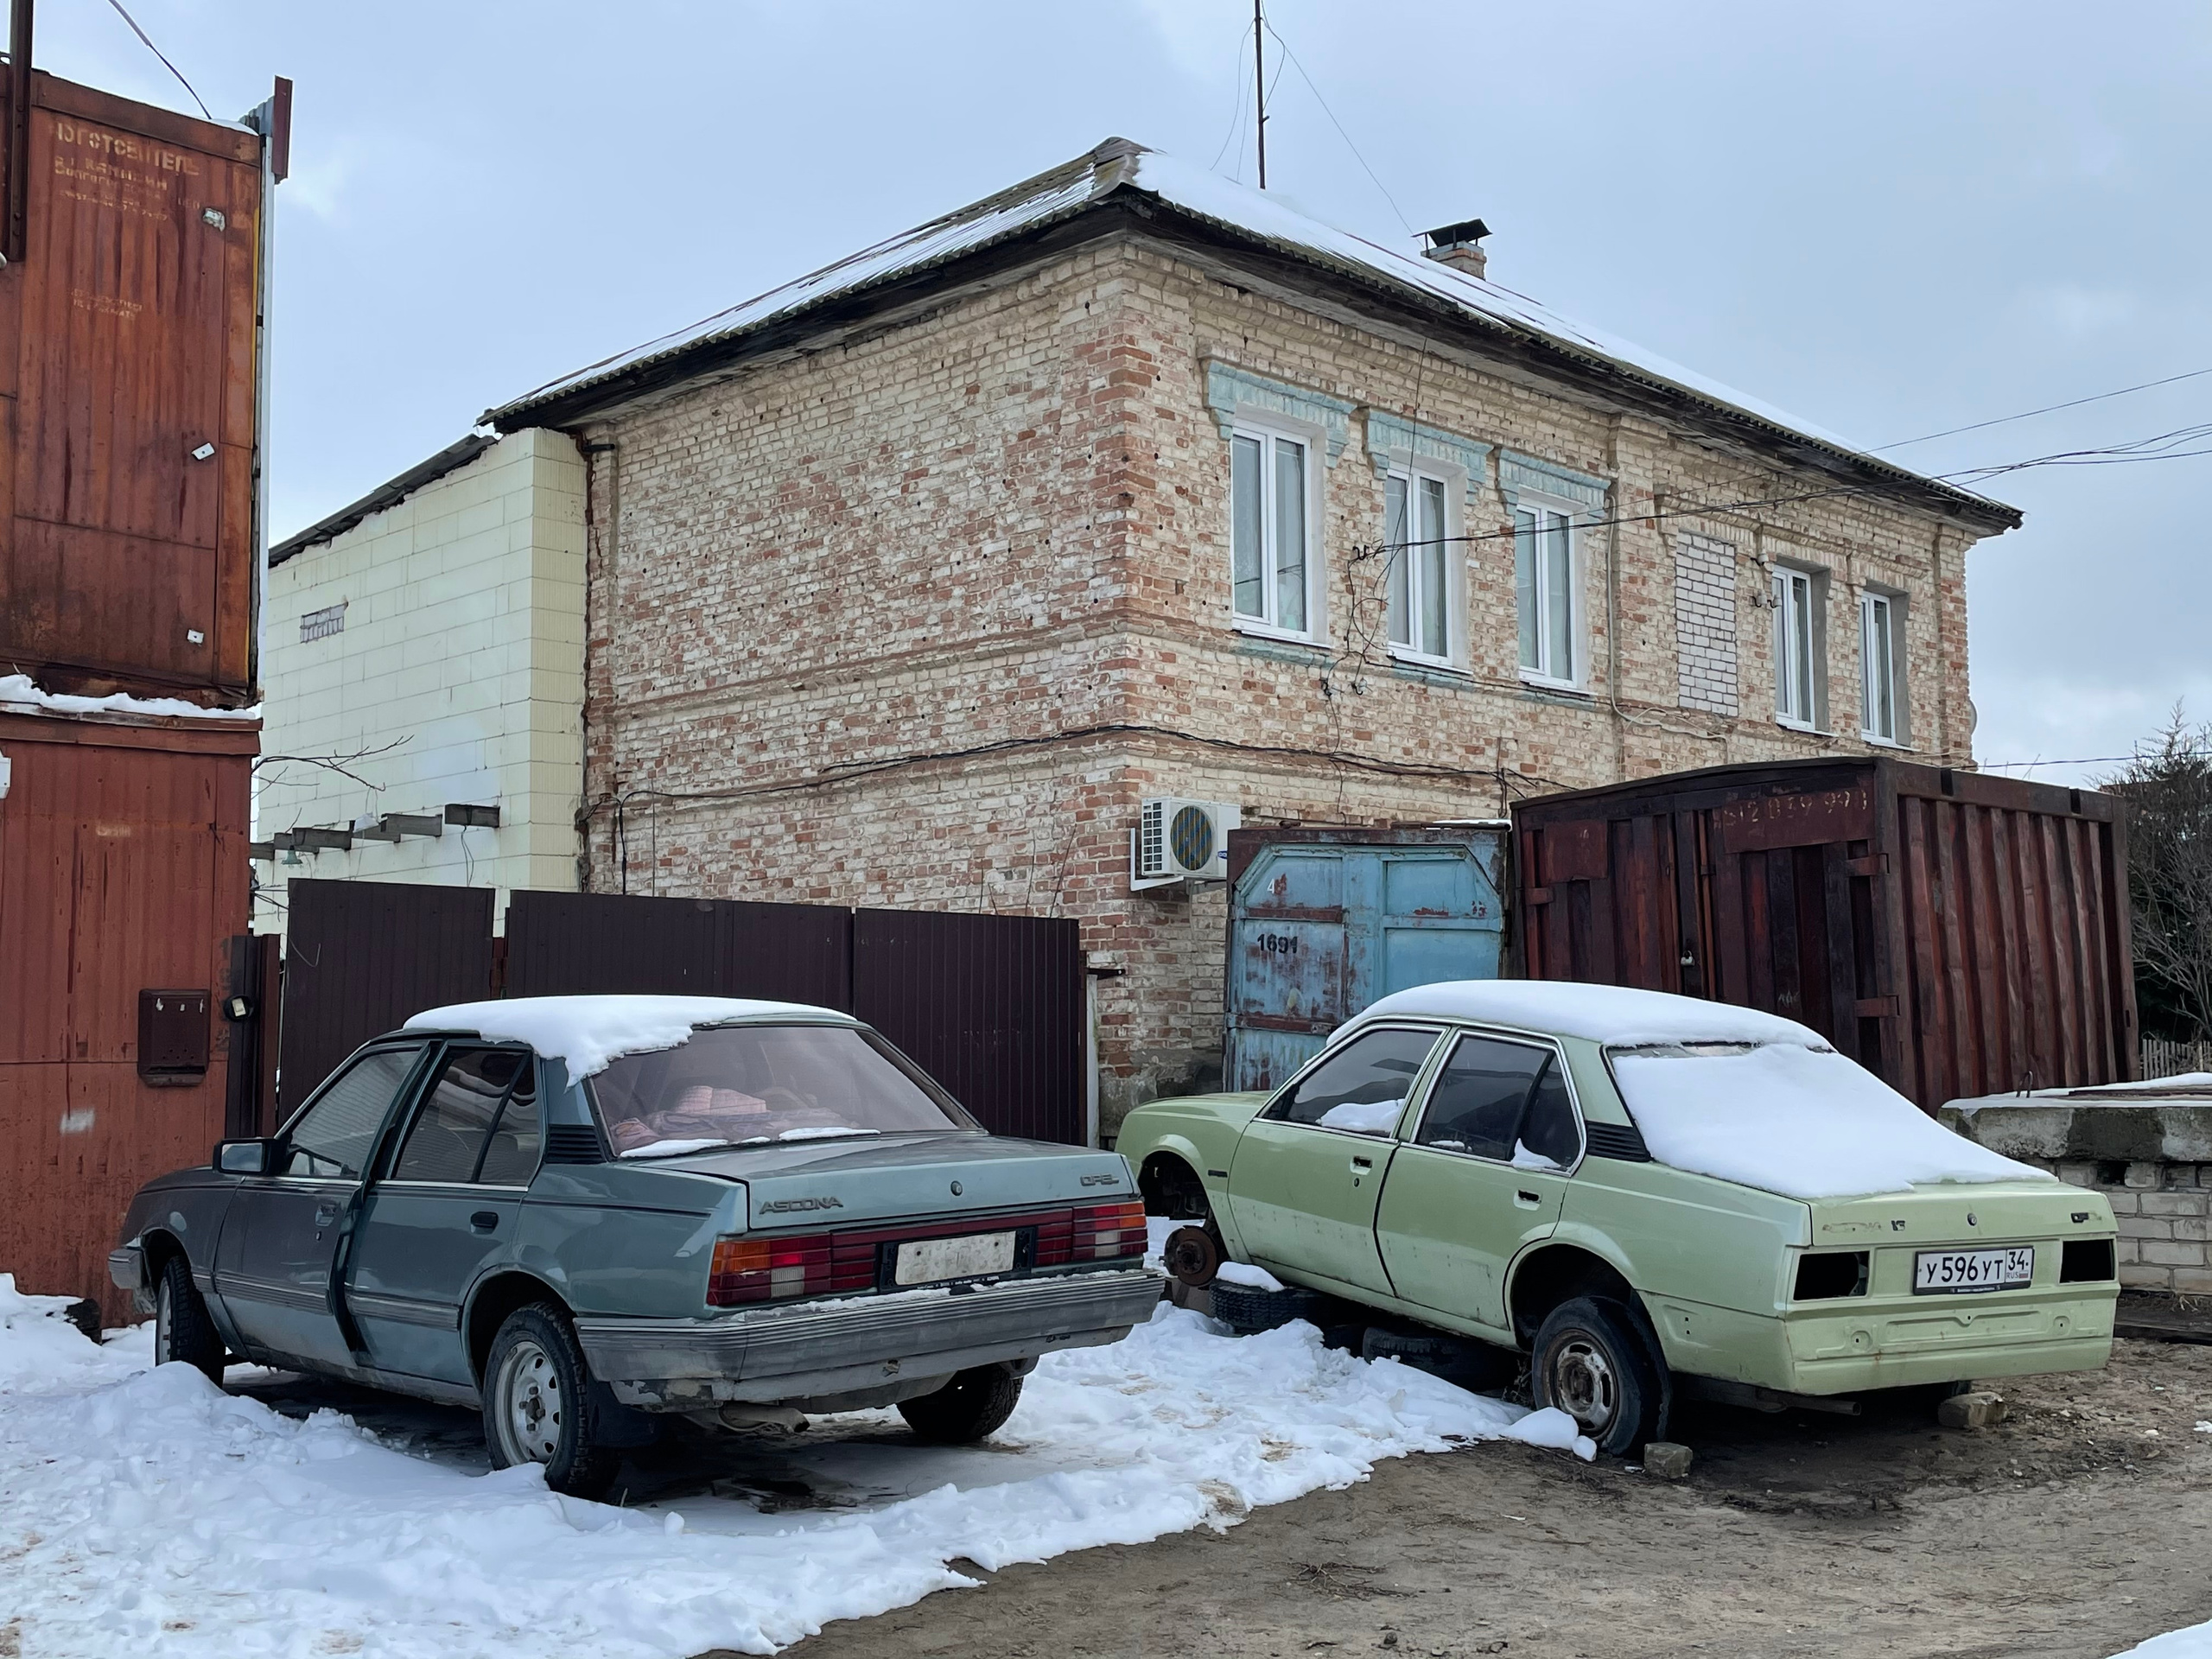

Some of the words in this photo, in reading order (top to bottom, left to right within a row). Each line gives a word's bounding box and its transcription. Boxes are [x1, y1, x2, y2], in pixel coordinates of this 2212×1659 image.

[1257, 933, 1298, 954] 1691
[1079, 1173, 1120, 1186] OPEL
[759, 1196, 844, 1215] ASCONA
[2005, 1271, 2019, 1280] RUS
